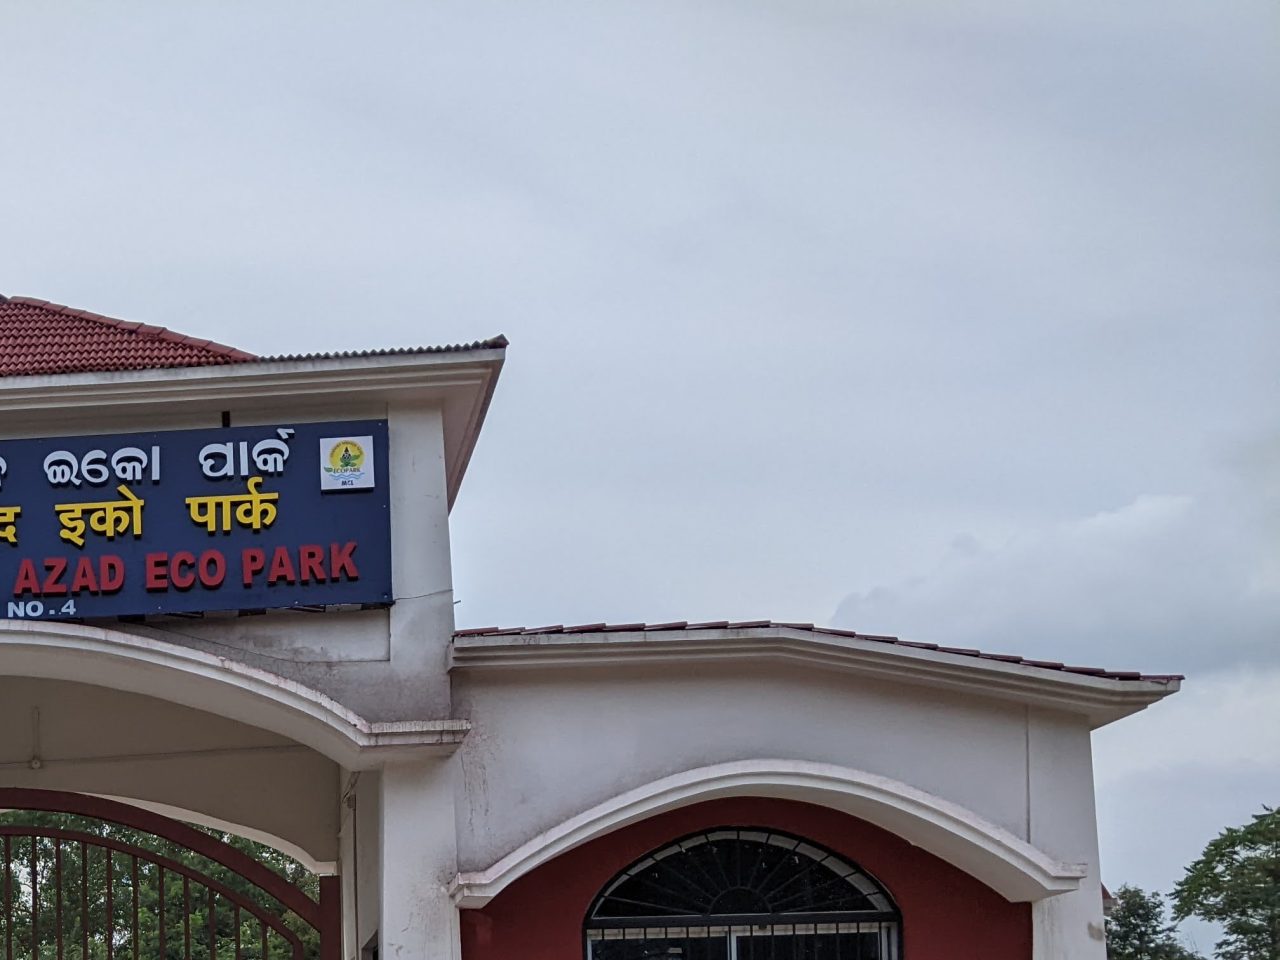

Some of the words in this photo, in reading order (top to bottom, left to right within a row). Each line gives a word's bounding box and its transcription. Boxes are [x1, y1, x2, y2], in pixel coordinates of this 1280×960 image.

[43, 445, 161, 486] ଇକୋ
[198, 428, 296, 478] ପାର୍କ
[55, 484, 145, 546] इको
[185, 476, 279, 532] पार्क
[15, 556, 124, 595] AZAD
[146, 549, 225, 588] ECO
[242, 542, 358, 584] PARK
